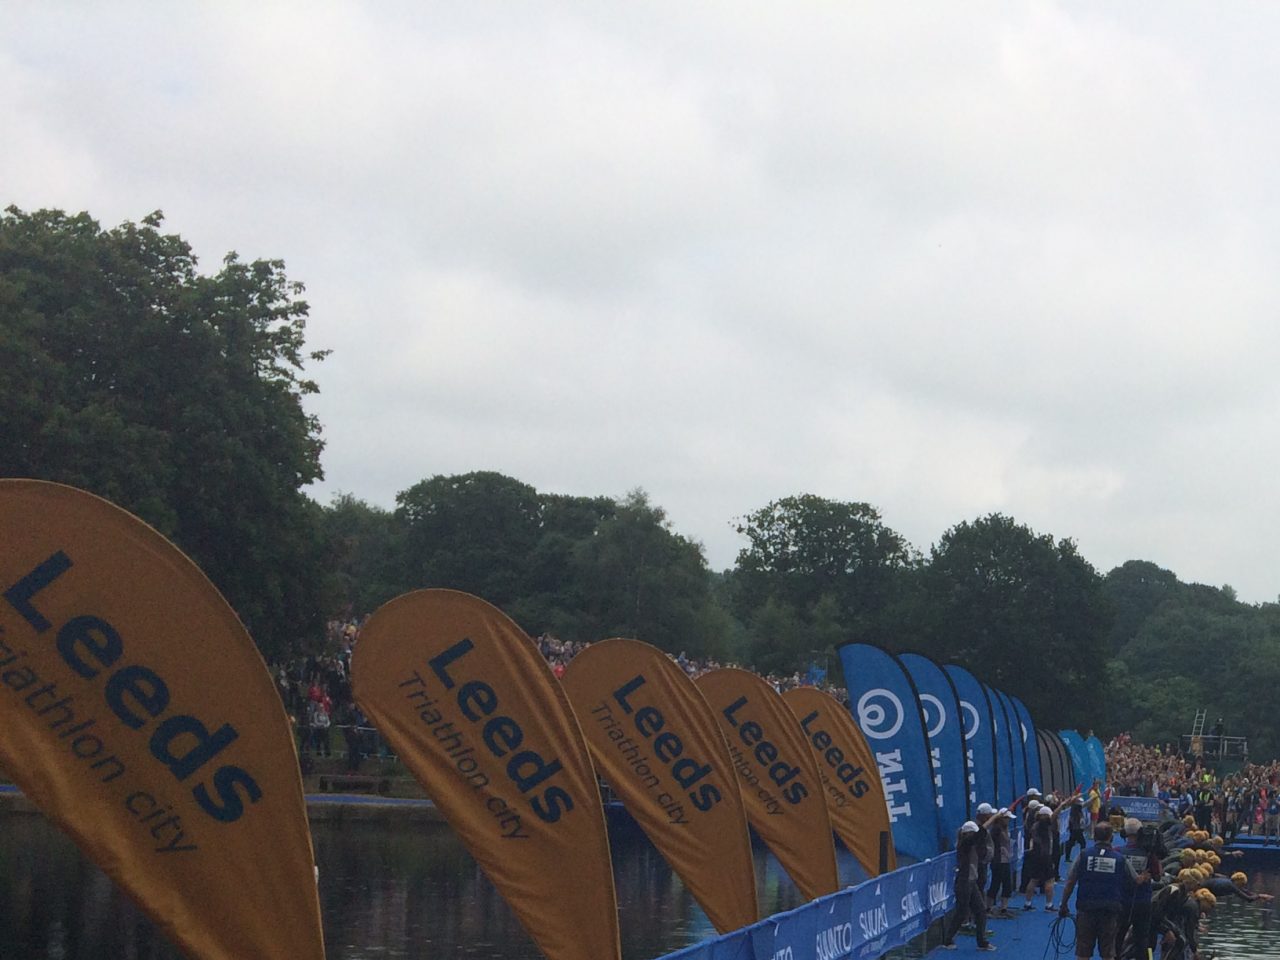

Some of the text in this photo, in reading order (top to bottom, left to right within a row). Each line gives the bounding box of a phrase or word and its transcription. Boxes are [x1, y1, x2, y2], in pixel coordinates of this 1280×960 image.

[0, 626, 198, 853] iathlon city
[1, 549, 263, 822] Leeds
[399, 669, 530, 838] Triathlon city
[428, 637, 574, 823] Leeds
[613, 674, 721, 812] Leeds
[722, 695, 808, 805] Leeds
[800, 709, 870, 798] Leeds
[592, 703, 689, 824] Triathlon city
[757, 787, 785, 815] city
